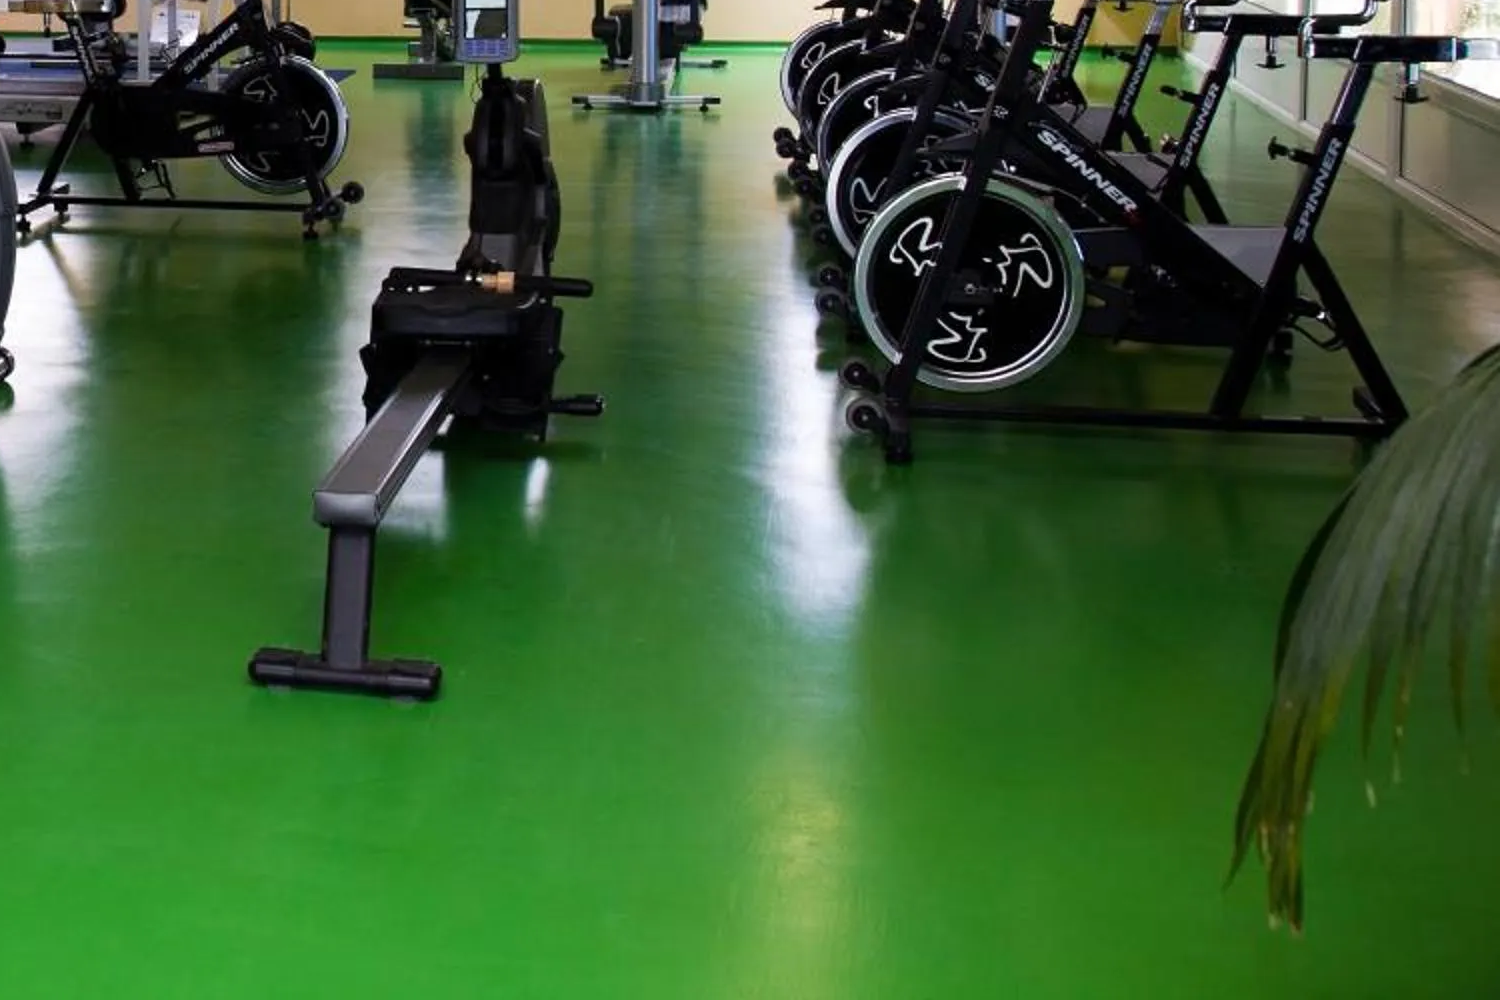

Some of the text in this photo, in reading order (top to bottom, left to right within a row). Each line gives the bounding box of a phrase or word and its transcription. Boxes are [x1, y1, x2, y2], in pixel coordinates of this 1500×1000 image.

[183, 21, 240, 75] SPINNER
[1179, 82, 1221, 169] SPINNER
[1037, 129, 1138, 214] SPINNER
[1292, 137, 1344, 244] SPINNER
